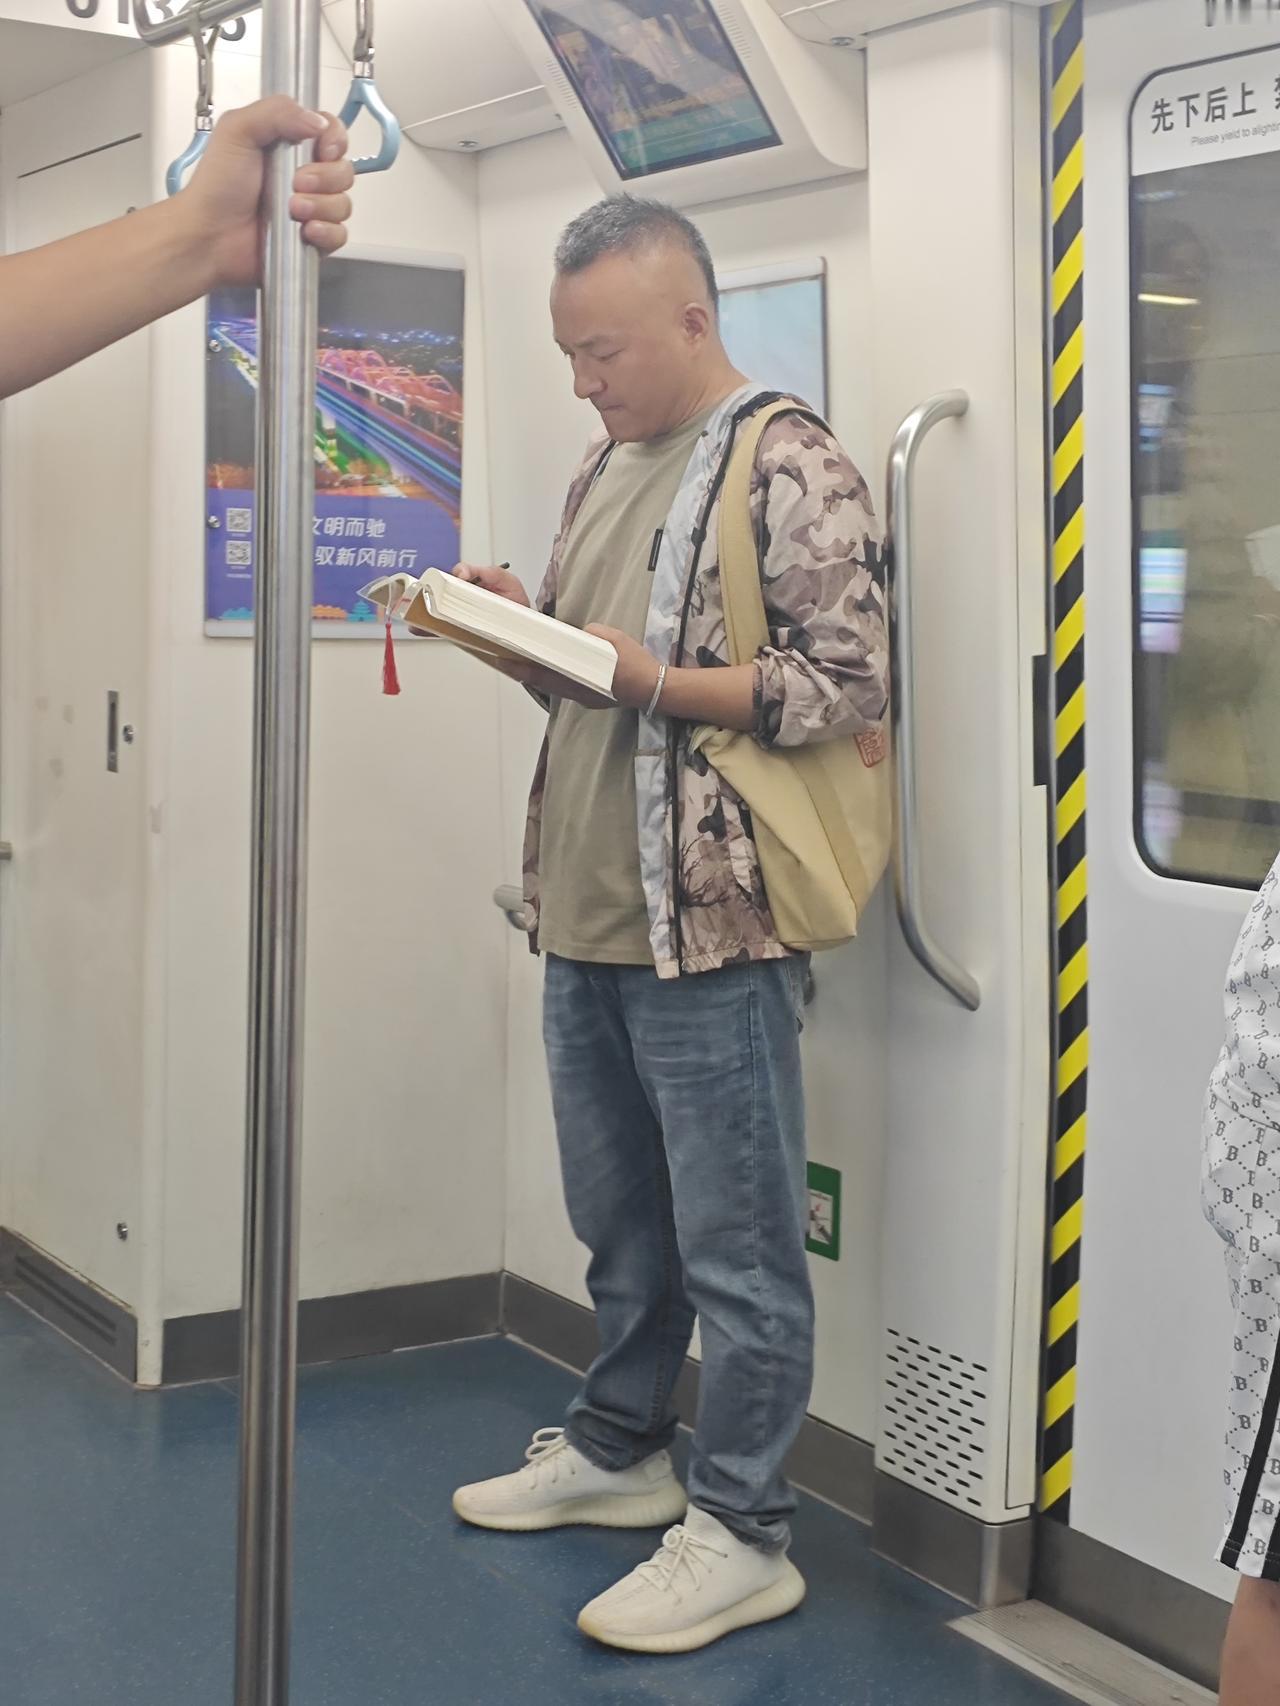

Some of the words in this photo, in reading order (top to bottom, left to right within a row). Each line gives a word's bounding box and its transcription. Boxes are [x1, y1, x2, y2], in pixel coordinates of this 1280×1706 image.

[1151, 82, 1257, 134] 先下后上
[1191, 134, 1219, 146] Please
[1220, 129, 1241, 143] yield
[1241, 128, 1251, 137] to
[314, 545, 418, 568] 驭新风前行
[1225, 1145, 1239, 1161] B
[1256, 1150, 1268, 1166] B
[1222, 1187, 1234, 1204] B
[1252, 1192, 1263, 1209] B
[1249, 1235, 1260, 1253] B
[1248, 1278, 1262, 1293] B
[1253, 1318, 1268, 1332] B
[1233, 1375, 1247, 1391] B
[1237, 1414, 1251, 1429] B
[1261, 1499, 1274, 1515] B
